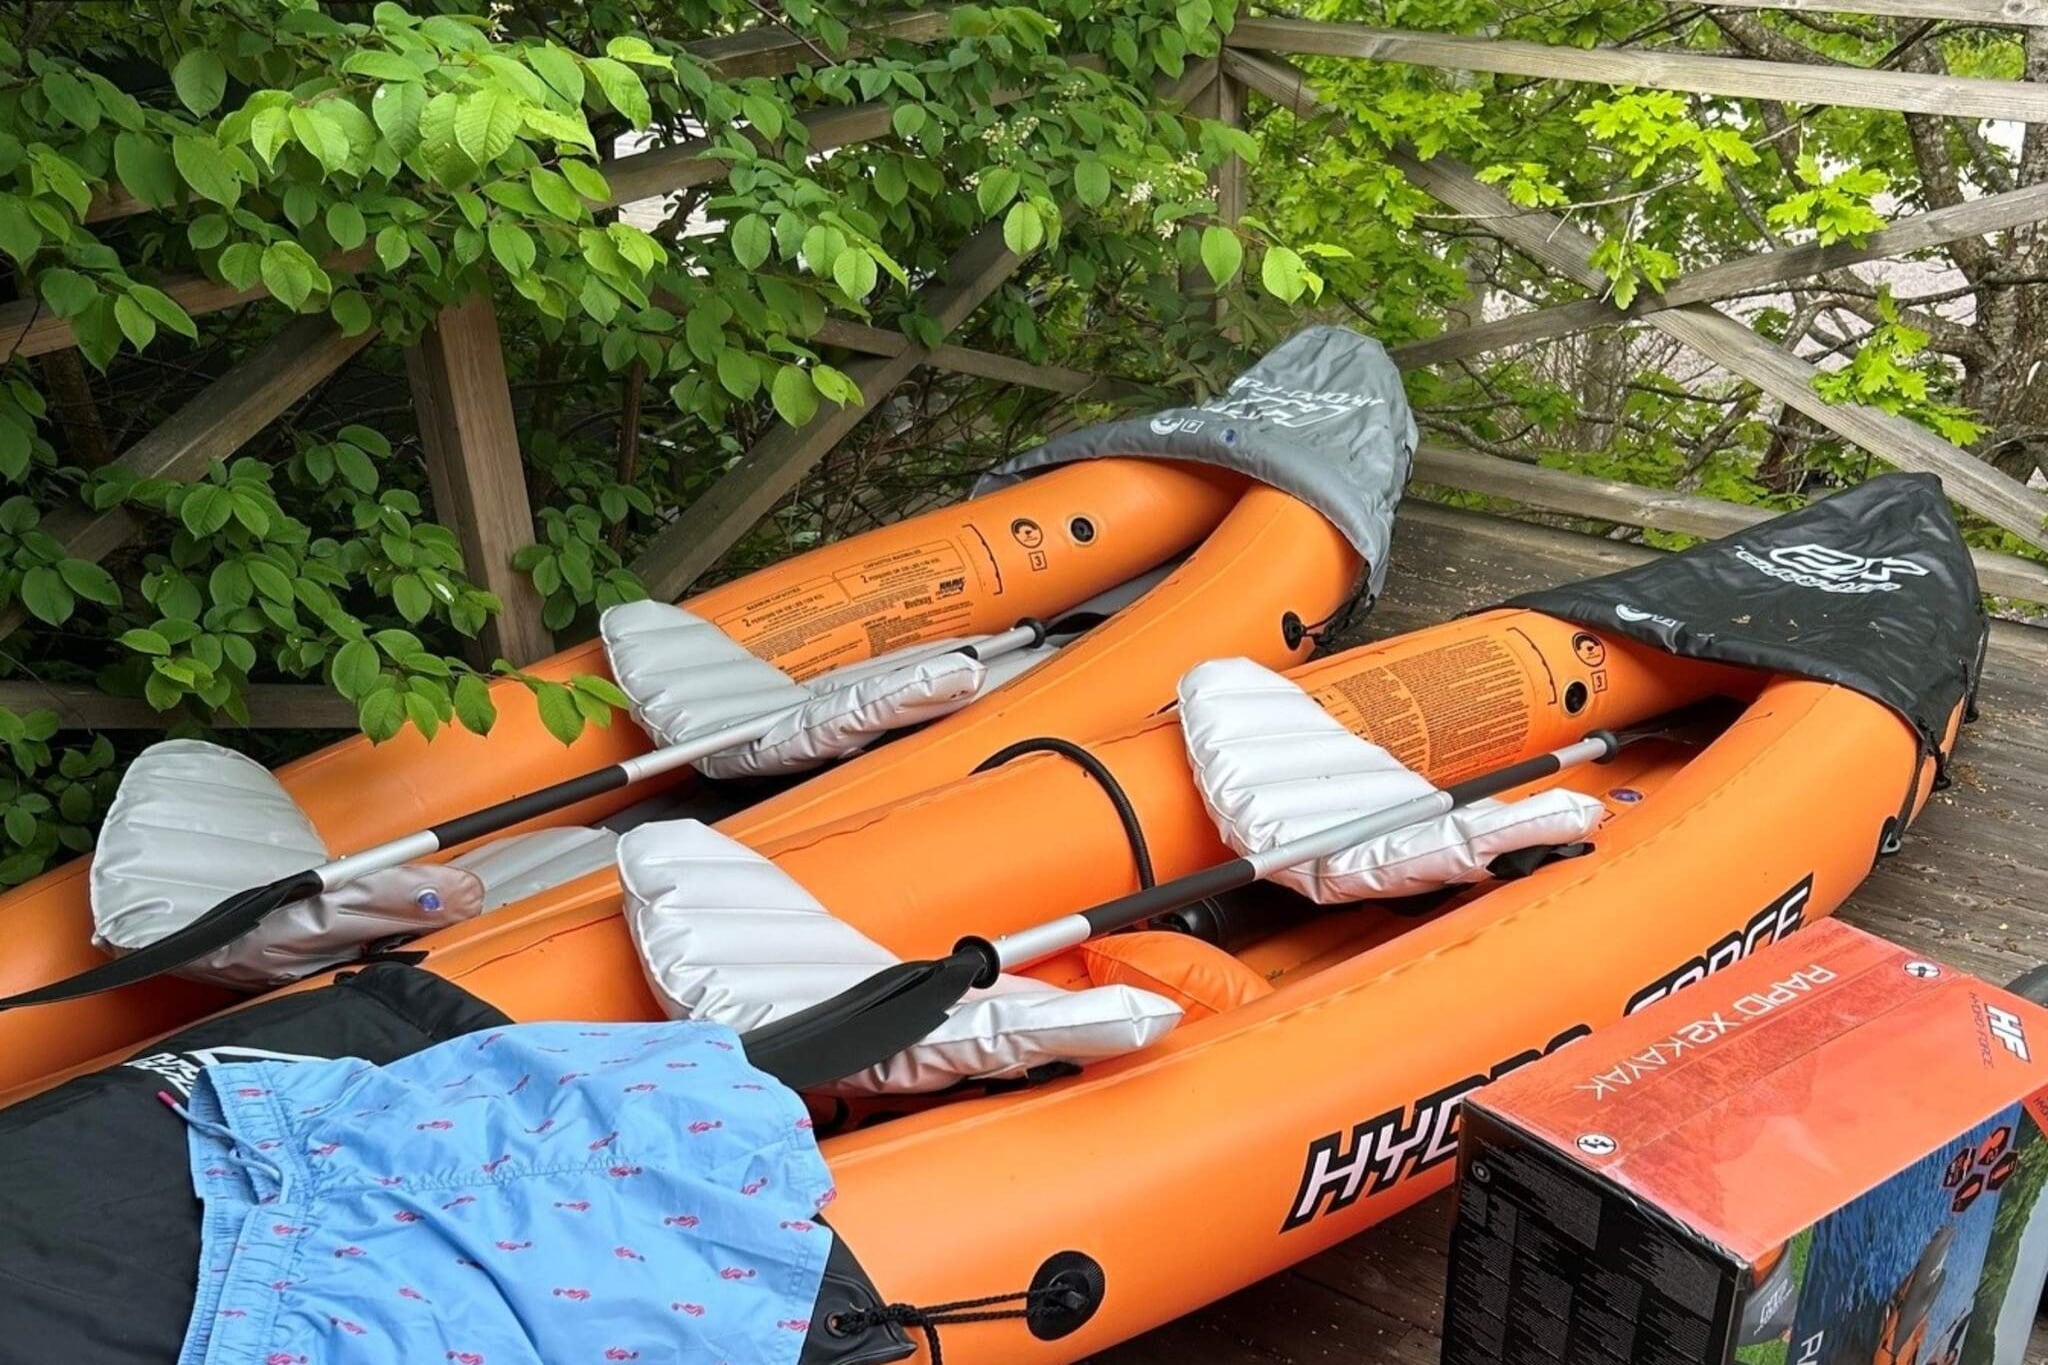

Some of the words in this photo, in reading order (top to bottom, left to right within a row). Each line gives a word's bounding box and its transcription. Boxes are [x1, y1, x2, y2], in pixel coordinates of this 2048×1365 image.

[1732, 964, 1838, 1016] RAPID
[1677, 1012, 1743, 1044] X2
[1984, 1002, 2031, 1063] HF
[1573, 1036, 1695, 1101] KAYAK
[1280, 1024, 1592, 1234] HYD
